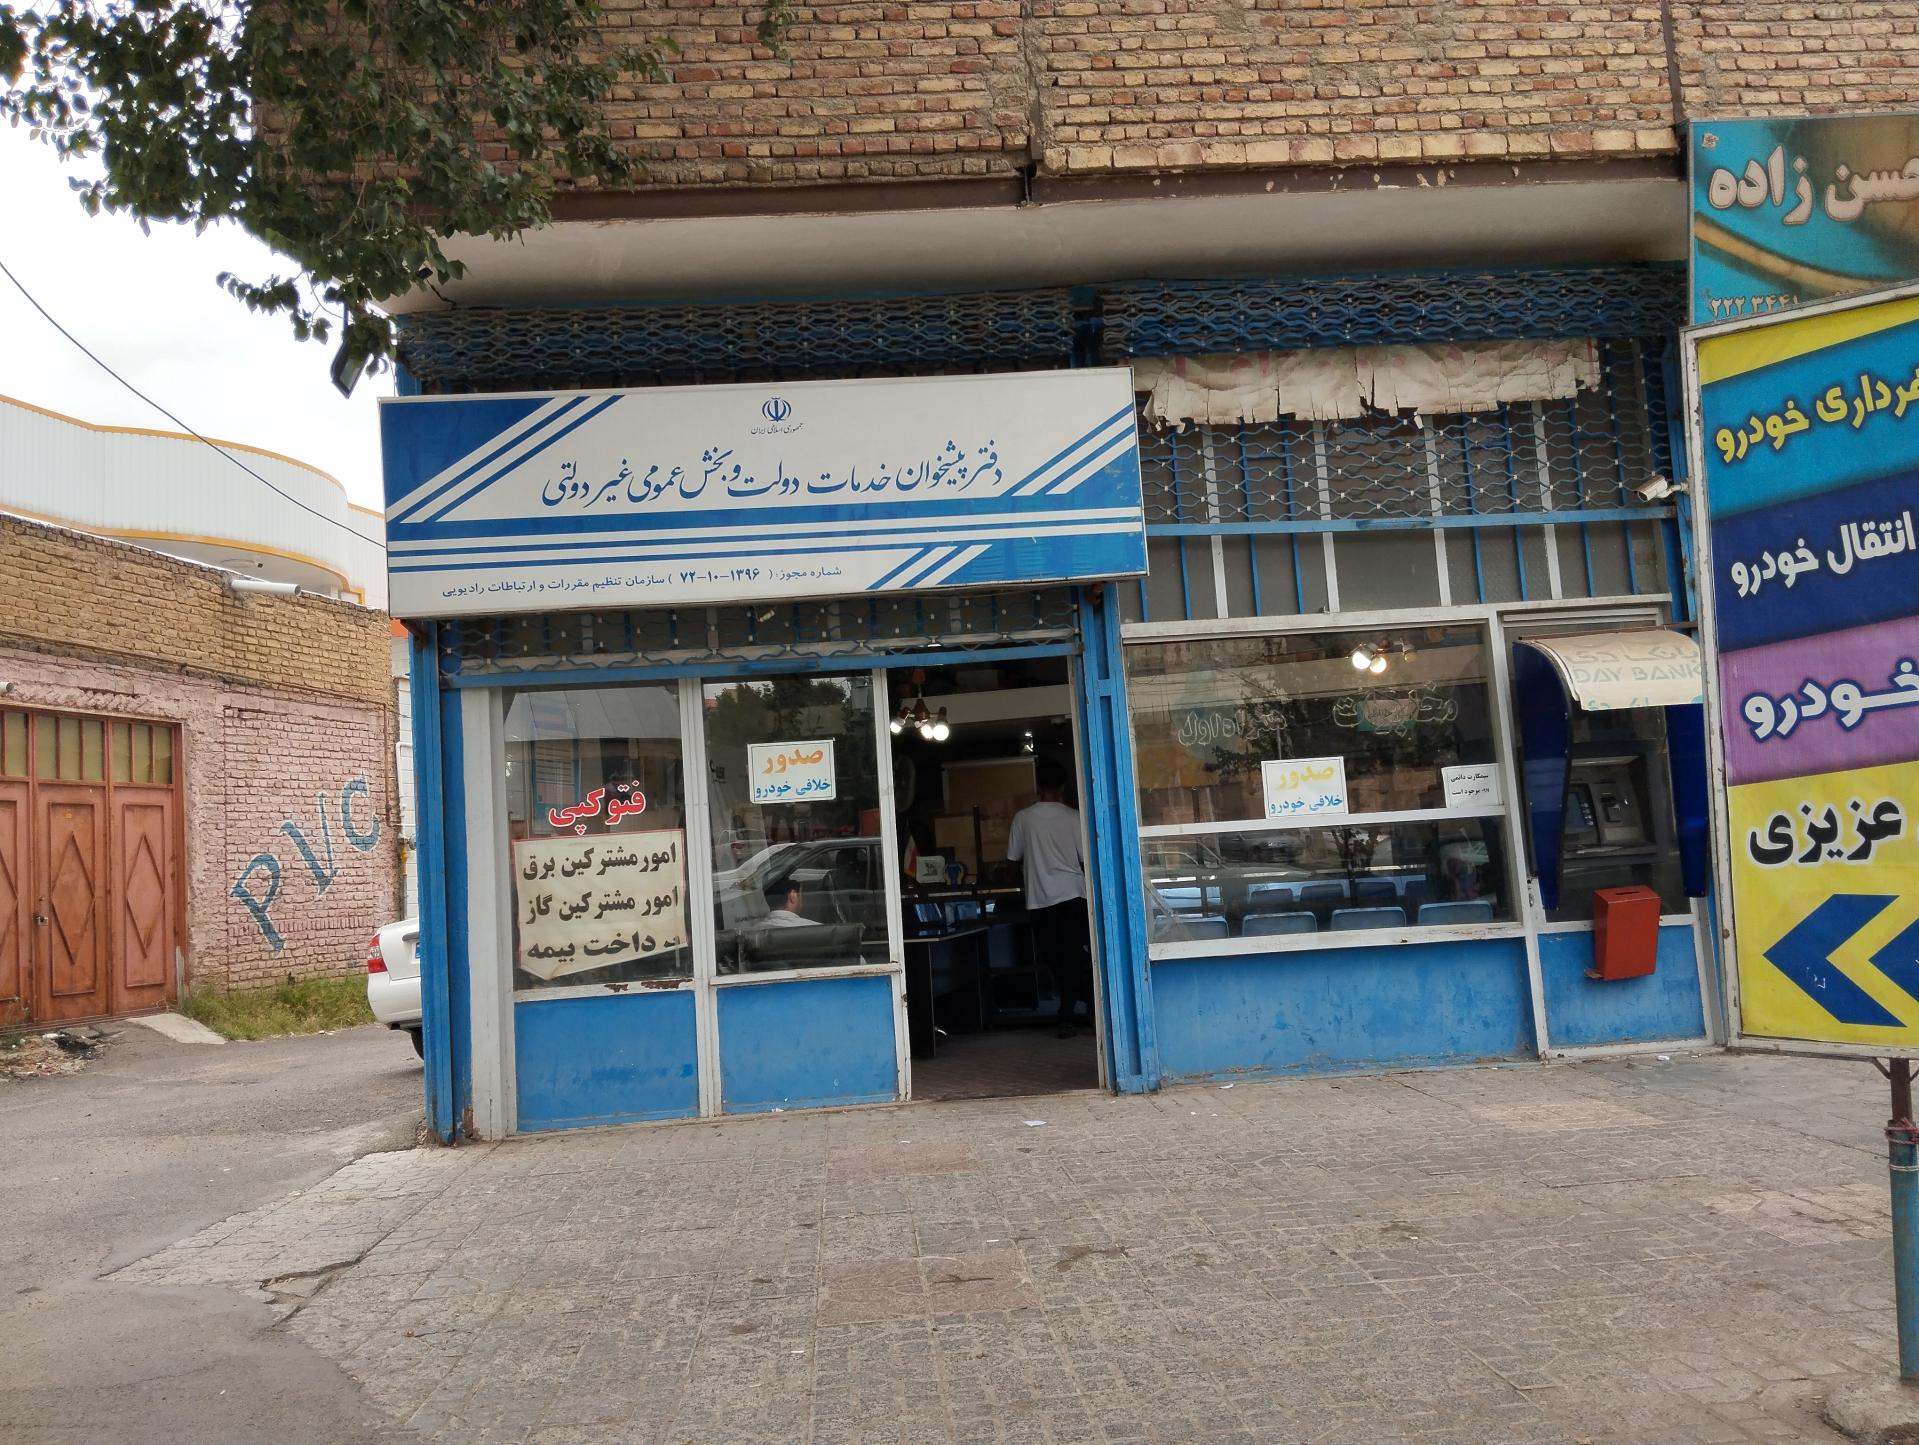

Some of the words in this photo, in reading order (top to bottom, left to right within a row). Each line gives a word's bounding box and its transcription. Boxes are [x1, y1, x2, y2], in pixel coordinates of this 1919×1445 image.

[1709, 144, 1812, 225] زاده
[1824, 156, 1919, 221] سن
[1716, 400, 1810, 463] خودرو
[679, 446, 734, 499] بخش
[728, 460, 799, 497] دولت
[730, 463, 742, 482] و
[807, 463, 891, 494] خدمات
[895, 439, 967, 492] پیشخوان
[959, 439, 1003, 492] دفتر
[627, 464, 685, 503] عمومی
[1827, 511, 1917, 575] انتقال
[625, 574, 665, 588] سازمان
[810, 565, 842, 579] شماره
[1731, 538, 1820, 598] خودرو
[442, 583, 485, 597] رادیویی
[488, 580, 535, 593] ارتباطات
[539, 583, 545, 592] و
[548, 578, 590, 592] مقررات
[592, 575, 622, 593] تنظیم
[1573, 666, 1622, 683] DAY
[1744, 661, 1919, 739] خودرو
[762, 749, 824, 774] صدور
[755, 781, 792, 799] خودرو
[796, 778, 831, 796] خلافی
[1274, 765, 1335, 791] صدور
[1270, 796, 1305, 814] خودرو
[1309, 794, 1343, 812] خلافی
[1749, 798, 1902, 865] عزیزی
[229, 770, 381, 957] PVC
[523, 855, 556, 881] برق
[561, 846, 638, 878] مشترکین
[639, 842, 676, 873] امور
[525, 893, 553, 925] گاز
[559, 889, 636, 921] مشترکین
[641, 885, 678, 917] امور
[527, 942, 576, 963] بیمه
